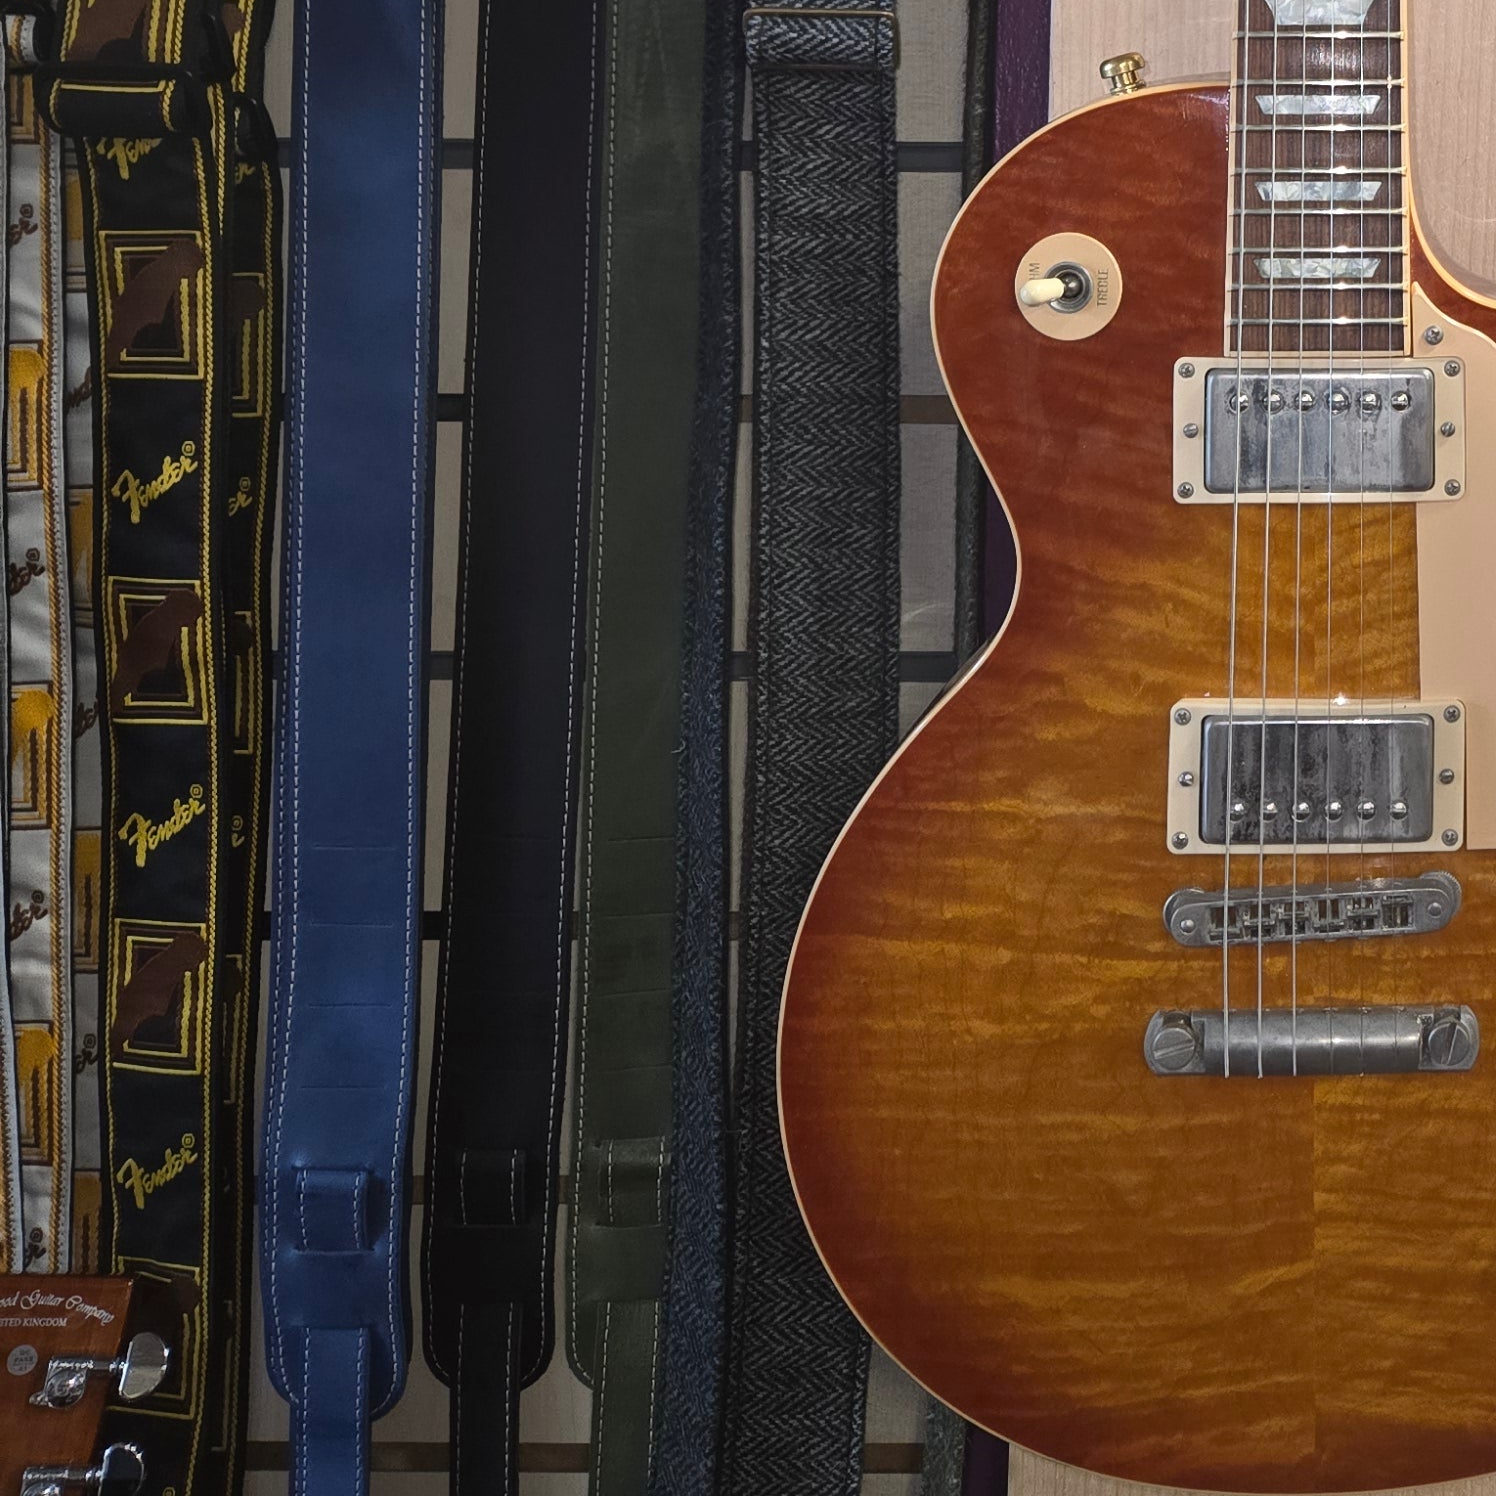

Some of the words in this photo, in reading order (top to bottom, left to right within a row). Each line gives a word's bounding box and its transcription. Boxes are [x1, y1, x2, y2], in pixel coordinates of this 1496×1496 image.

[111, 455, 199, 524] Fender
[117, 798, 206, 868] Fender
[116, 1147, 199, 1210] Fender
[20, 1289, 65, 1310] Guitar
[65, 1295, 115, 1326] Company
[22, 1317, 68, 1327] KINGDOM
